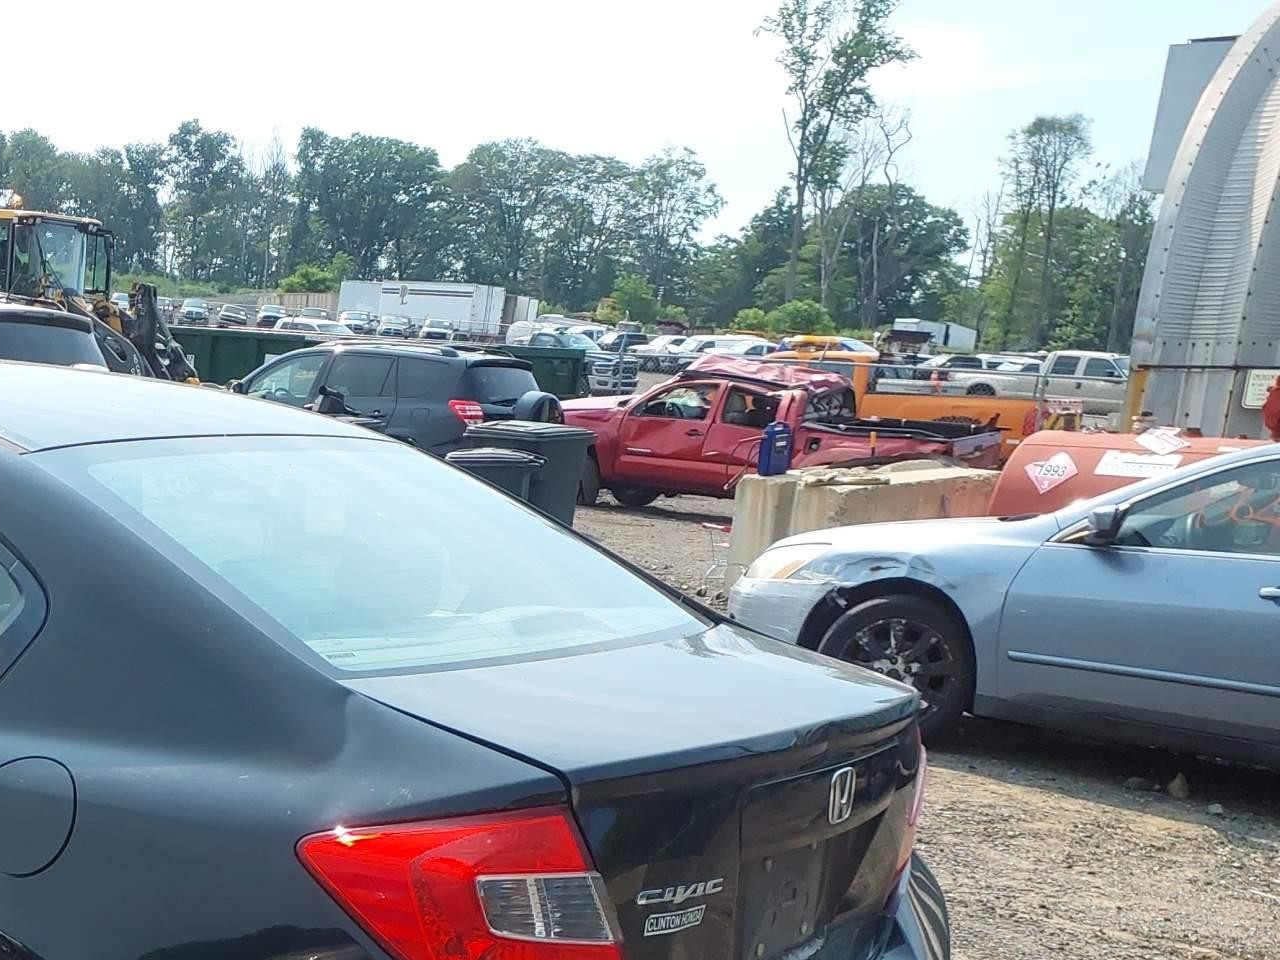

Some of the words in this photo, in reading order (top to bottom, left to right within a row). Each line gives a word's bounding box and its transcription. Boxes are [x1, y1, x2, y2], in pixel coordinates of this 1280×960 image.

[1036, 463, 1068, 478] 1993
[637, 878, 724, 905] CIVIC
[647, 915, 681, 932] CLINTON
[681, 910, 702, 925] HONDA
